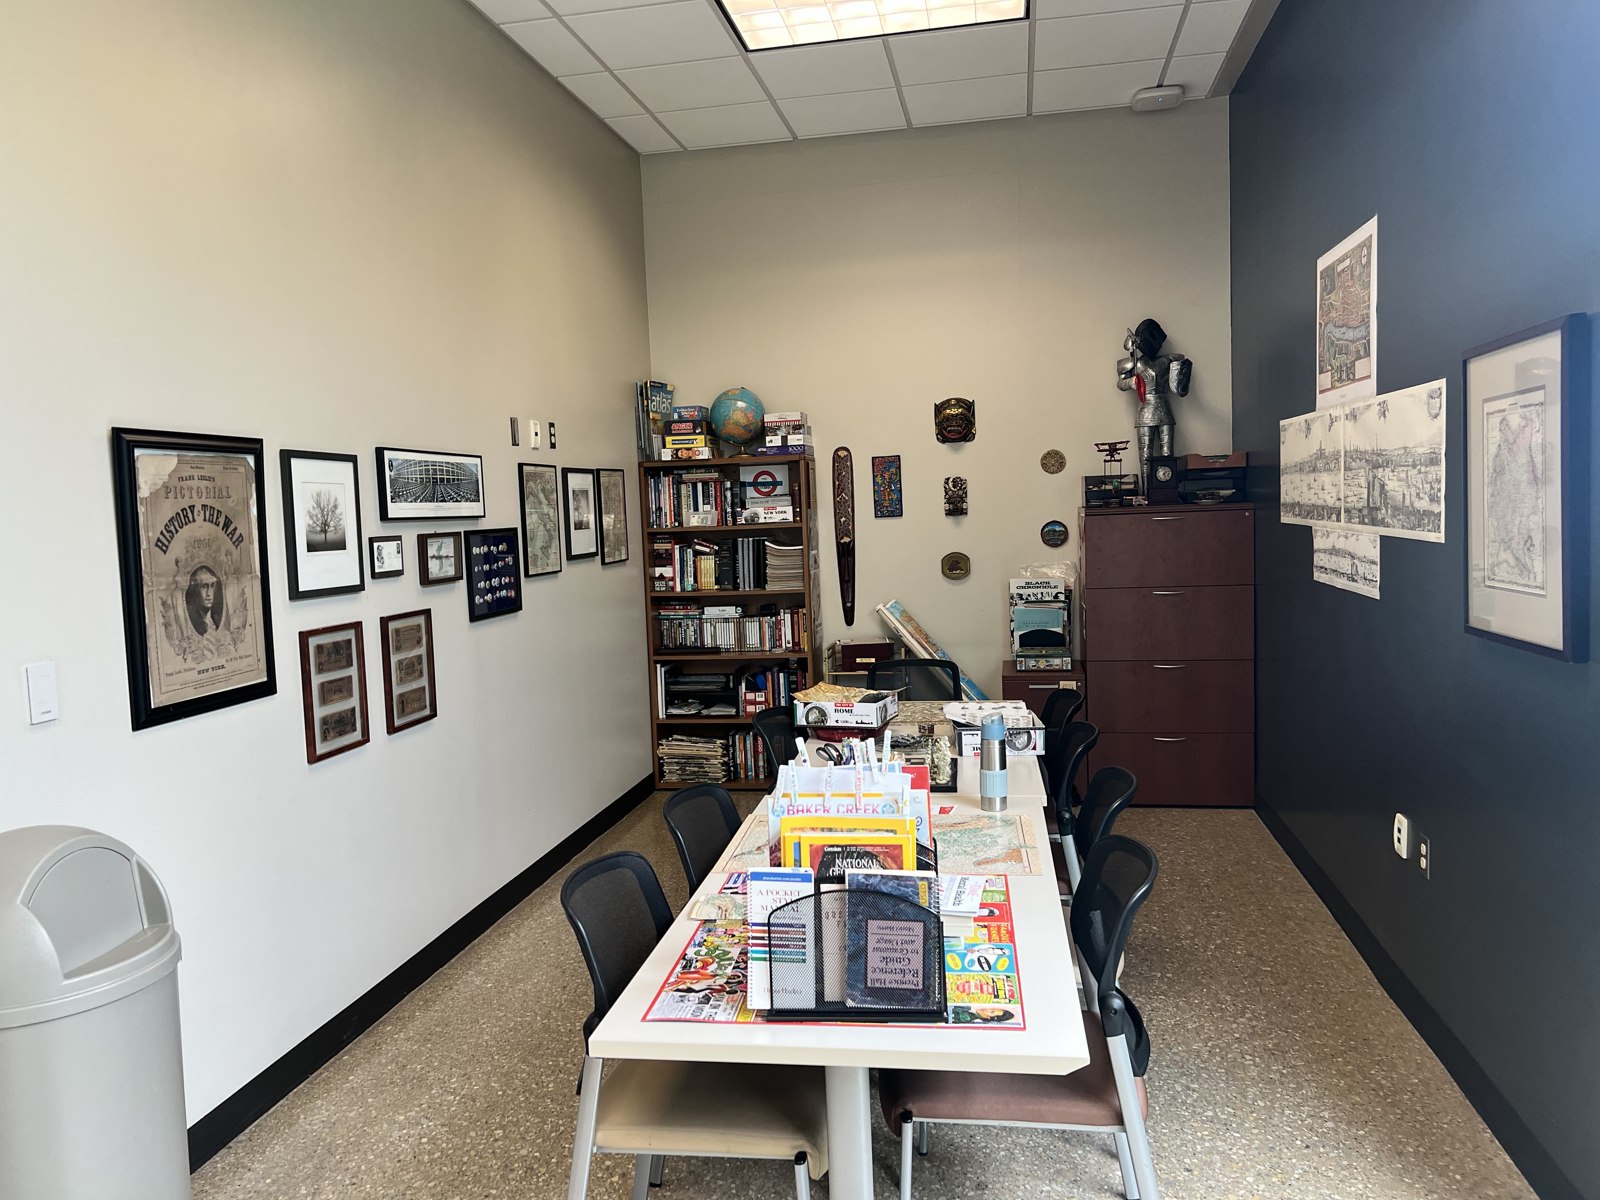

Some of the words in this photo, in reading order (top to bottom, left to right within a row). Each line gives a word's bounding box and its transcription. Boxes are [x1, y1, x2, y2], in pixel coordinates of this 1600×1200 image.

[652, 392, 671, 413] atlas
[164, 485, 232, 500] PICTORIAL
[155, 504, 196, 556] HISTORY
[201, 504, 222, 527] THE
[221, 514, 244, 550] WAR
[786, 803, 831, 815] BAKER
[836, 803, 880, 814] CREEK
[835, 858, 878, 869] NATIONAL
[880, 956, 911, 966] Guide
[871, 967, 919, 978] Reference
